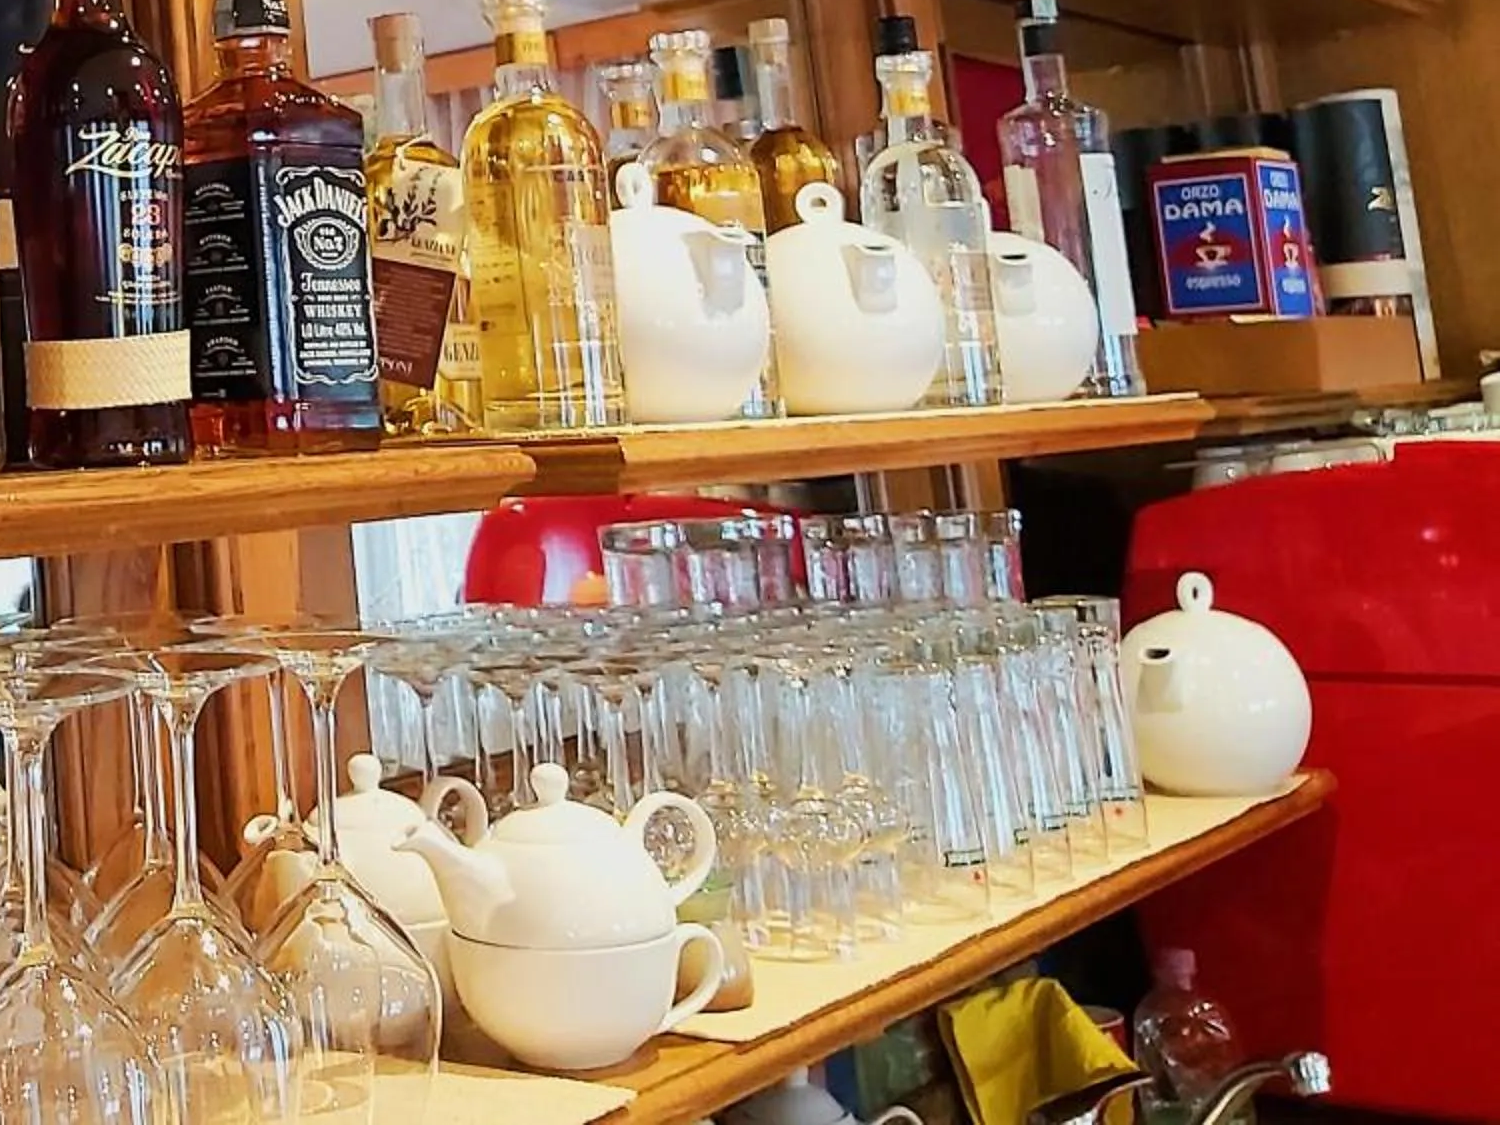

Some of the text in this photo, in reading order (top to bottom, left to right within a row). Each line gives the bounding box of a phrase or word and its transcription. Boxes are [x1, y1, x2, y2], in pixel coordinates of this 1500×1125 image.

[1180, 183, 1220, 201] ORZO
[272, 184, 317, 228] JACK
[1163, 198, 1244, 221] DAMA
[303, 303, 363, 319] WHISKEY
